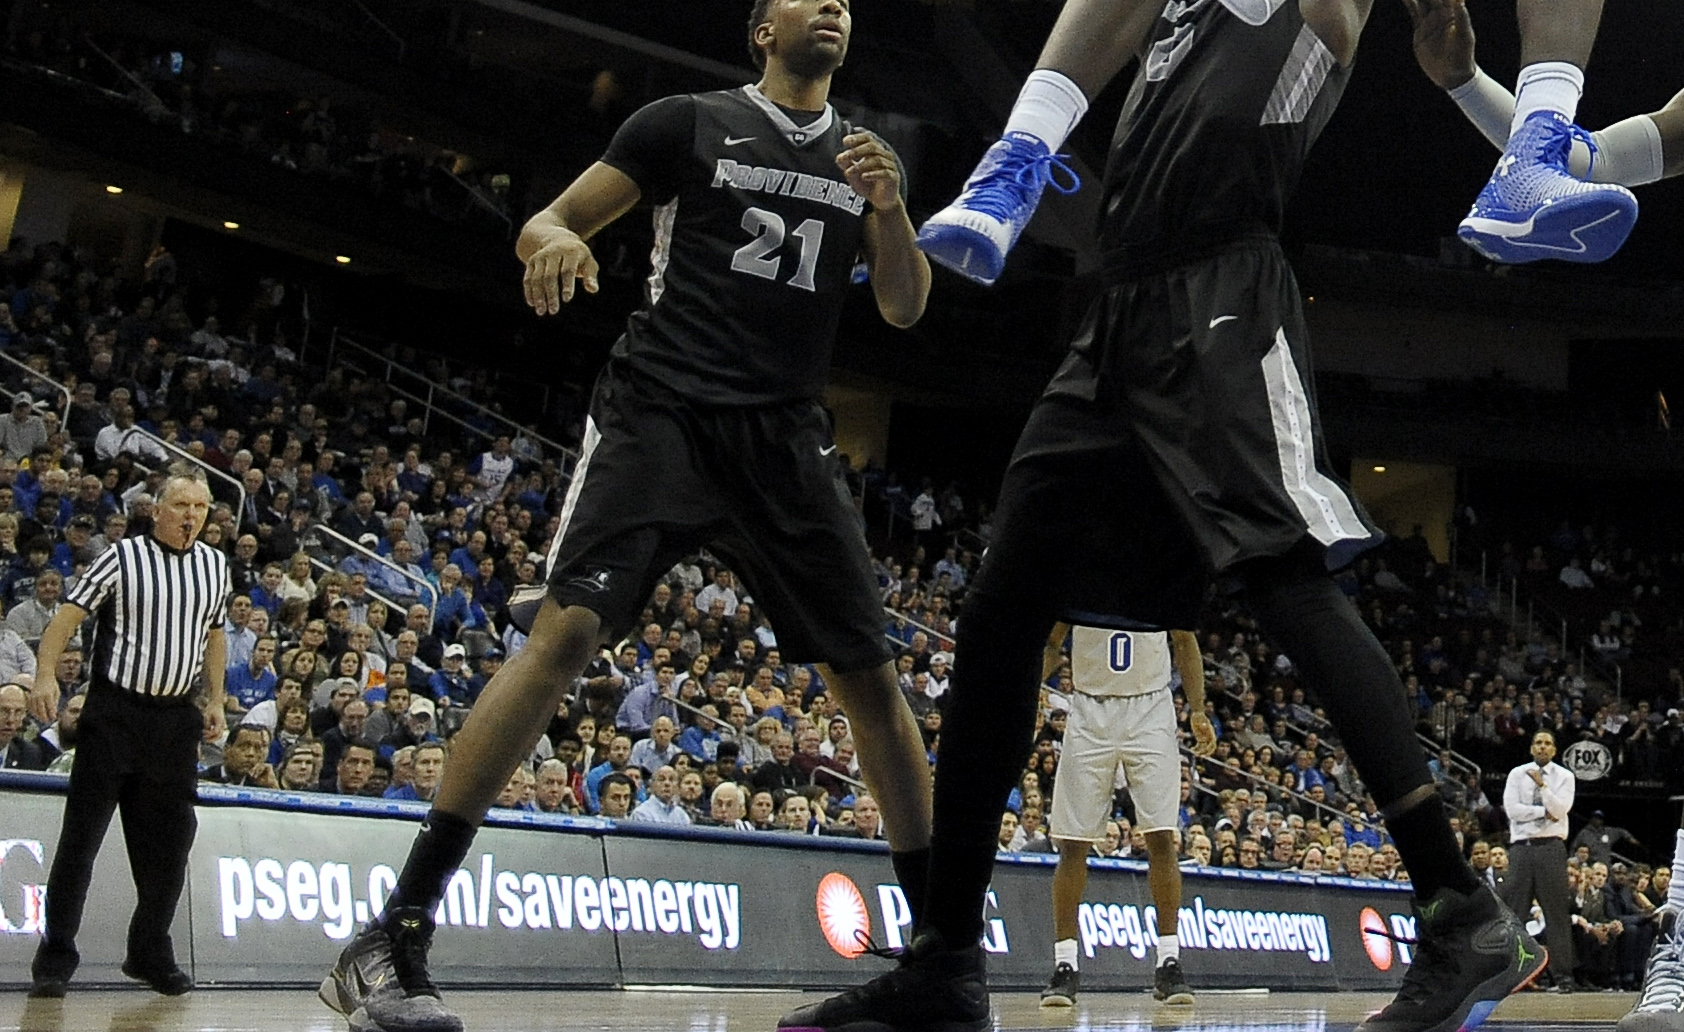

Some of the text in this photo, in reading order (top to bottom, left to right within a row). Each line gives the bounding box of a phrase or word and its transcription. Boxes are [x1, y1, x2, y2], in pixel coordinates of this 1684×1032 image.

[711, 158, 866, 217] PROVIDENCE
[730, 206, 825, 293] 21
[1106, 631, 1135, 674] 0
[1574, 749, 1601, 766] FOX
[217, 853, 741, 951] pseg.cm/saveenergy
[1078, 896, 1332, 963] pseg.cm/saveenergy
